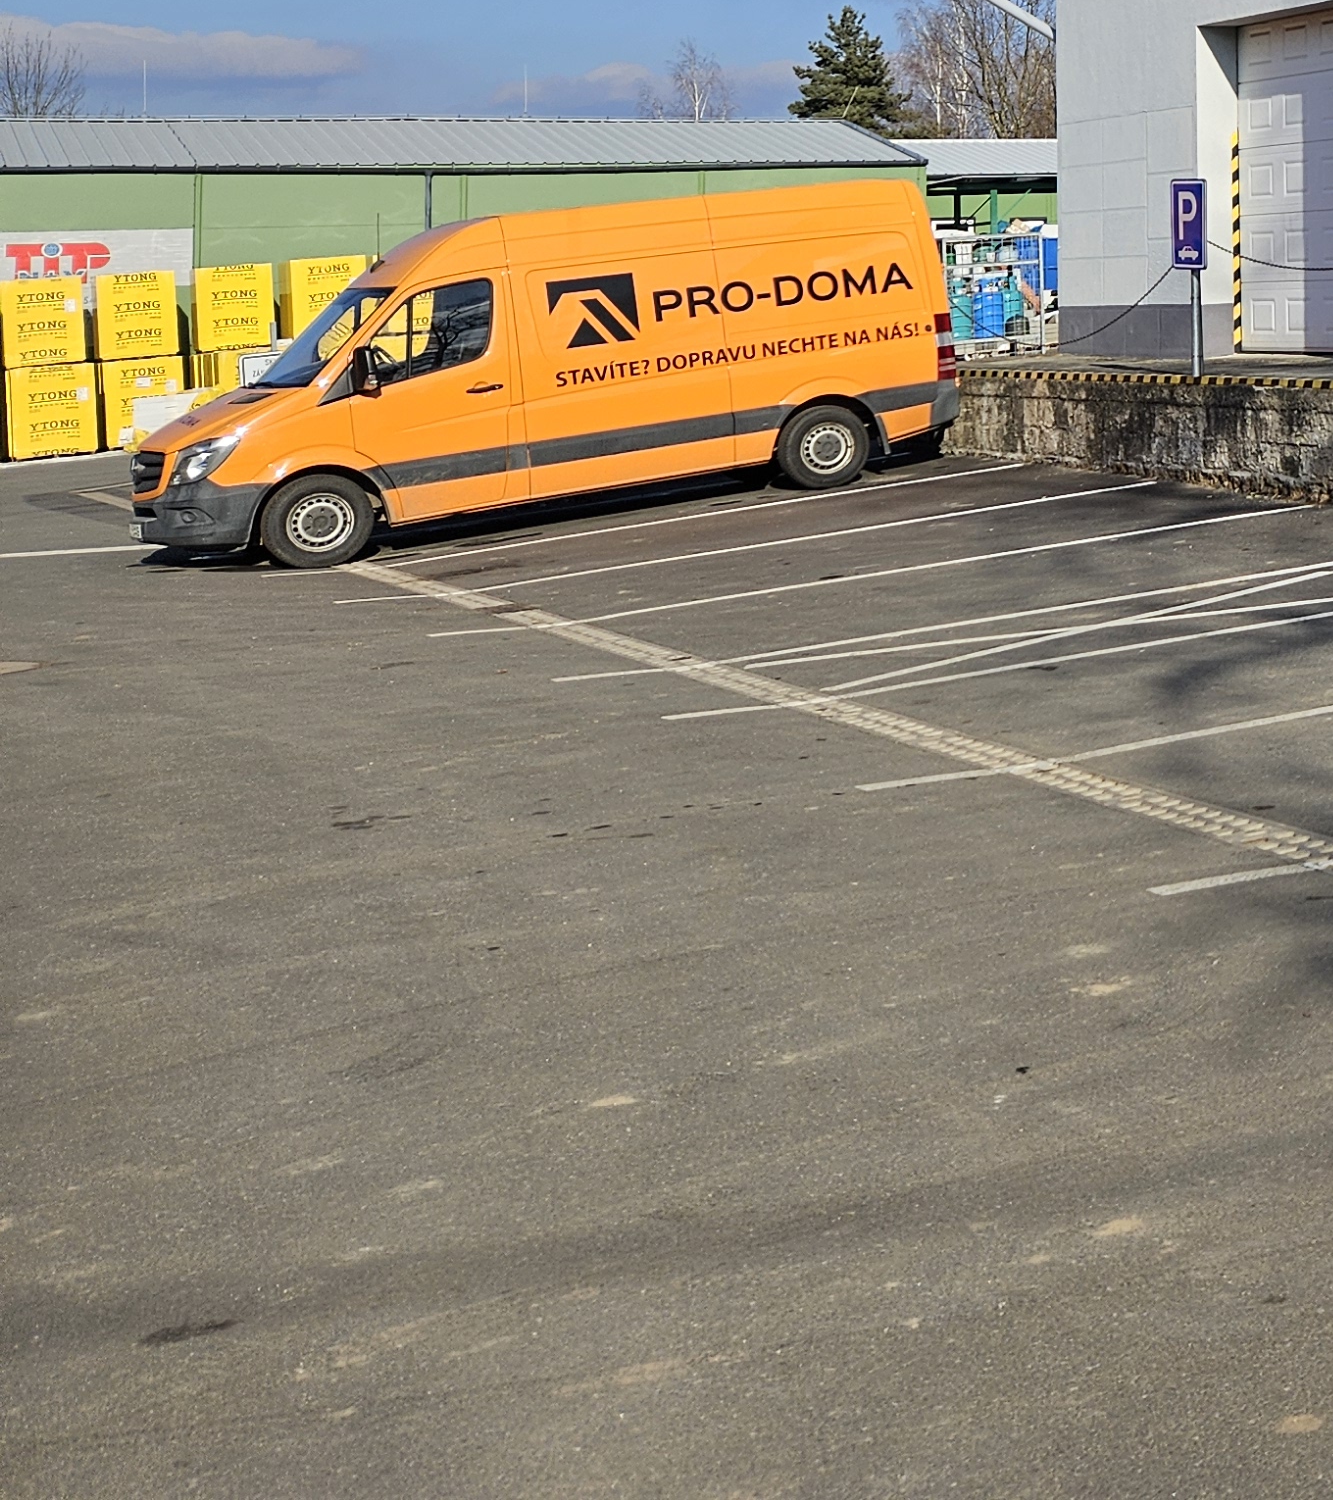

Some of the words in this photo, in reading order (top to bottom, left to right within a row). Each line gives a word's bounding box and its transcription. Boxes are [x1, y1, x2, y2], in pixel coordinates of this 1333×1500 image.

[1178, 190, 1197, 240] P
[114, 272, 157, 283] YTONG
[17, 291, 65, 302] YTONG
[211, 289, 257, 299] YTONG
[653, 262, 914, 322] PRO-DOMA
[113, 301, 161, 311] YTONG
[17, 320, 67, 331] YTONG
[213, 317, 258, 326] YTONG
[115, 328, 162, 338] YTONG
[20, 348, 67, 359] YTONG
[555, 359, 651, 388] STAVÍTE?
[656, 344, 757, 373] DOPRAVU
[761, 334, 839, 360] NECHTE
[844, 330, 872, 347] NA
[875, 321, 920, 341] NÁS!
[121, 366, 166, 377] YTONG
[28, 390, 77, 401] YTONG
[29, 419, 80, 431] YTONG
